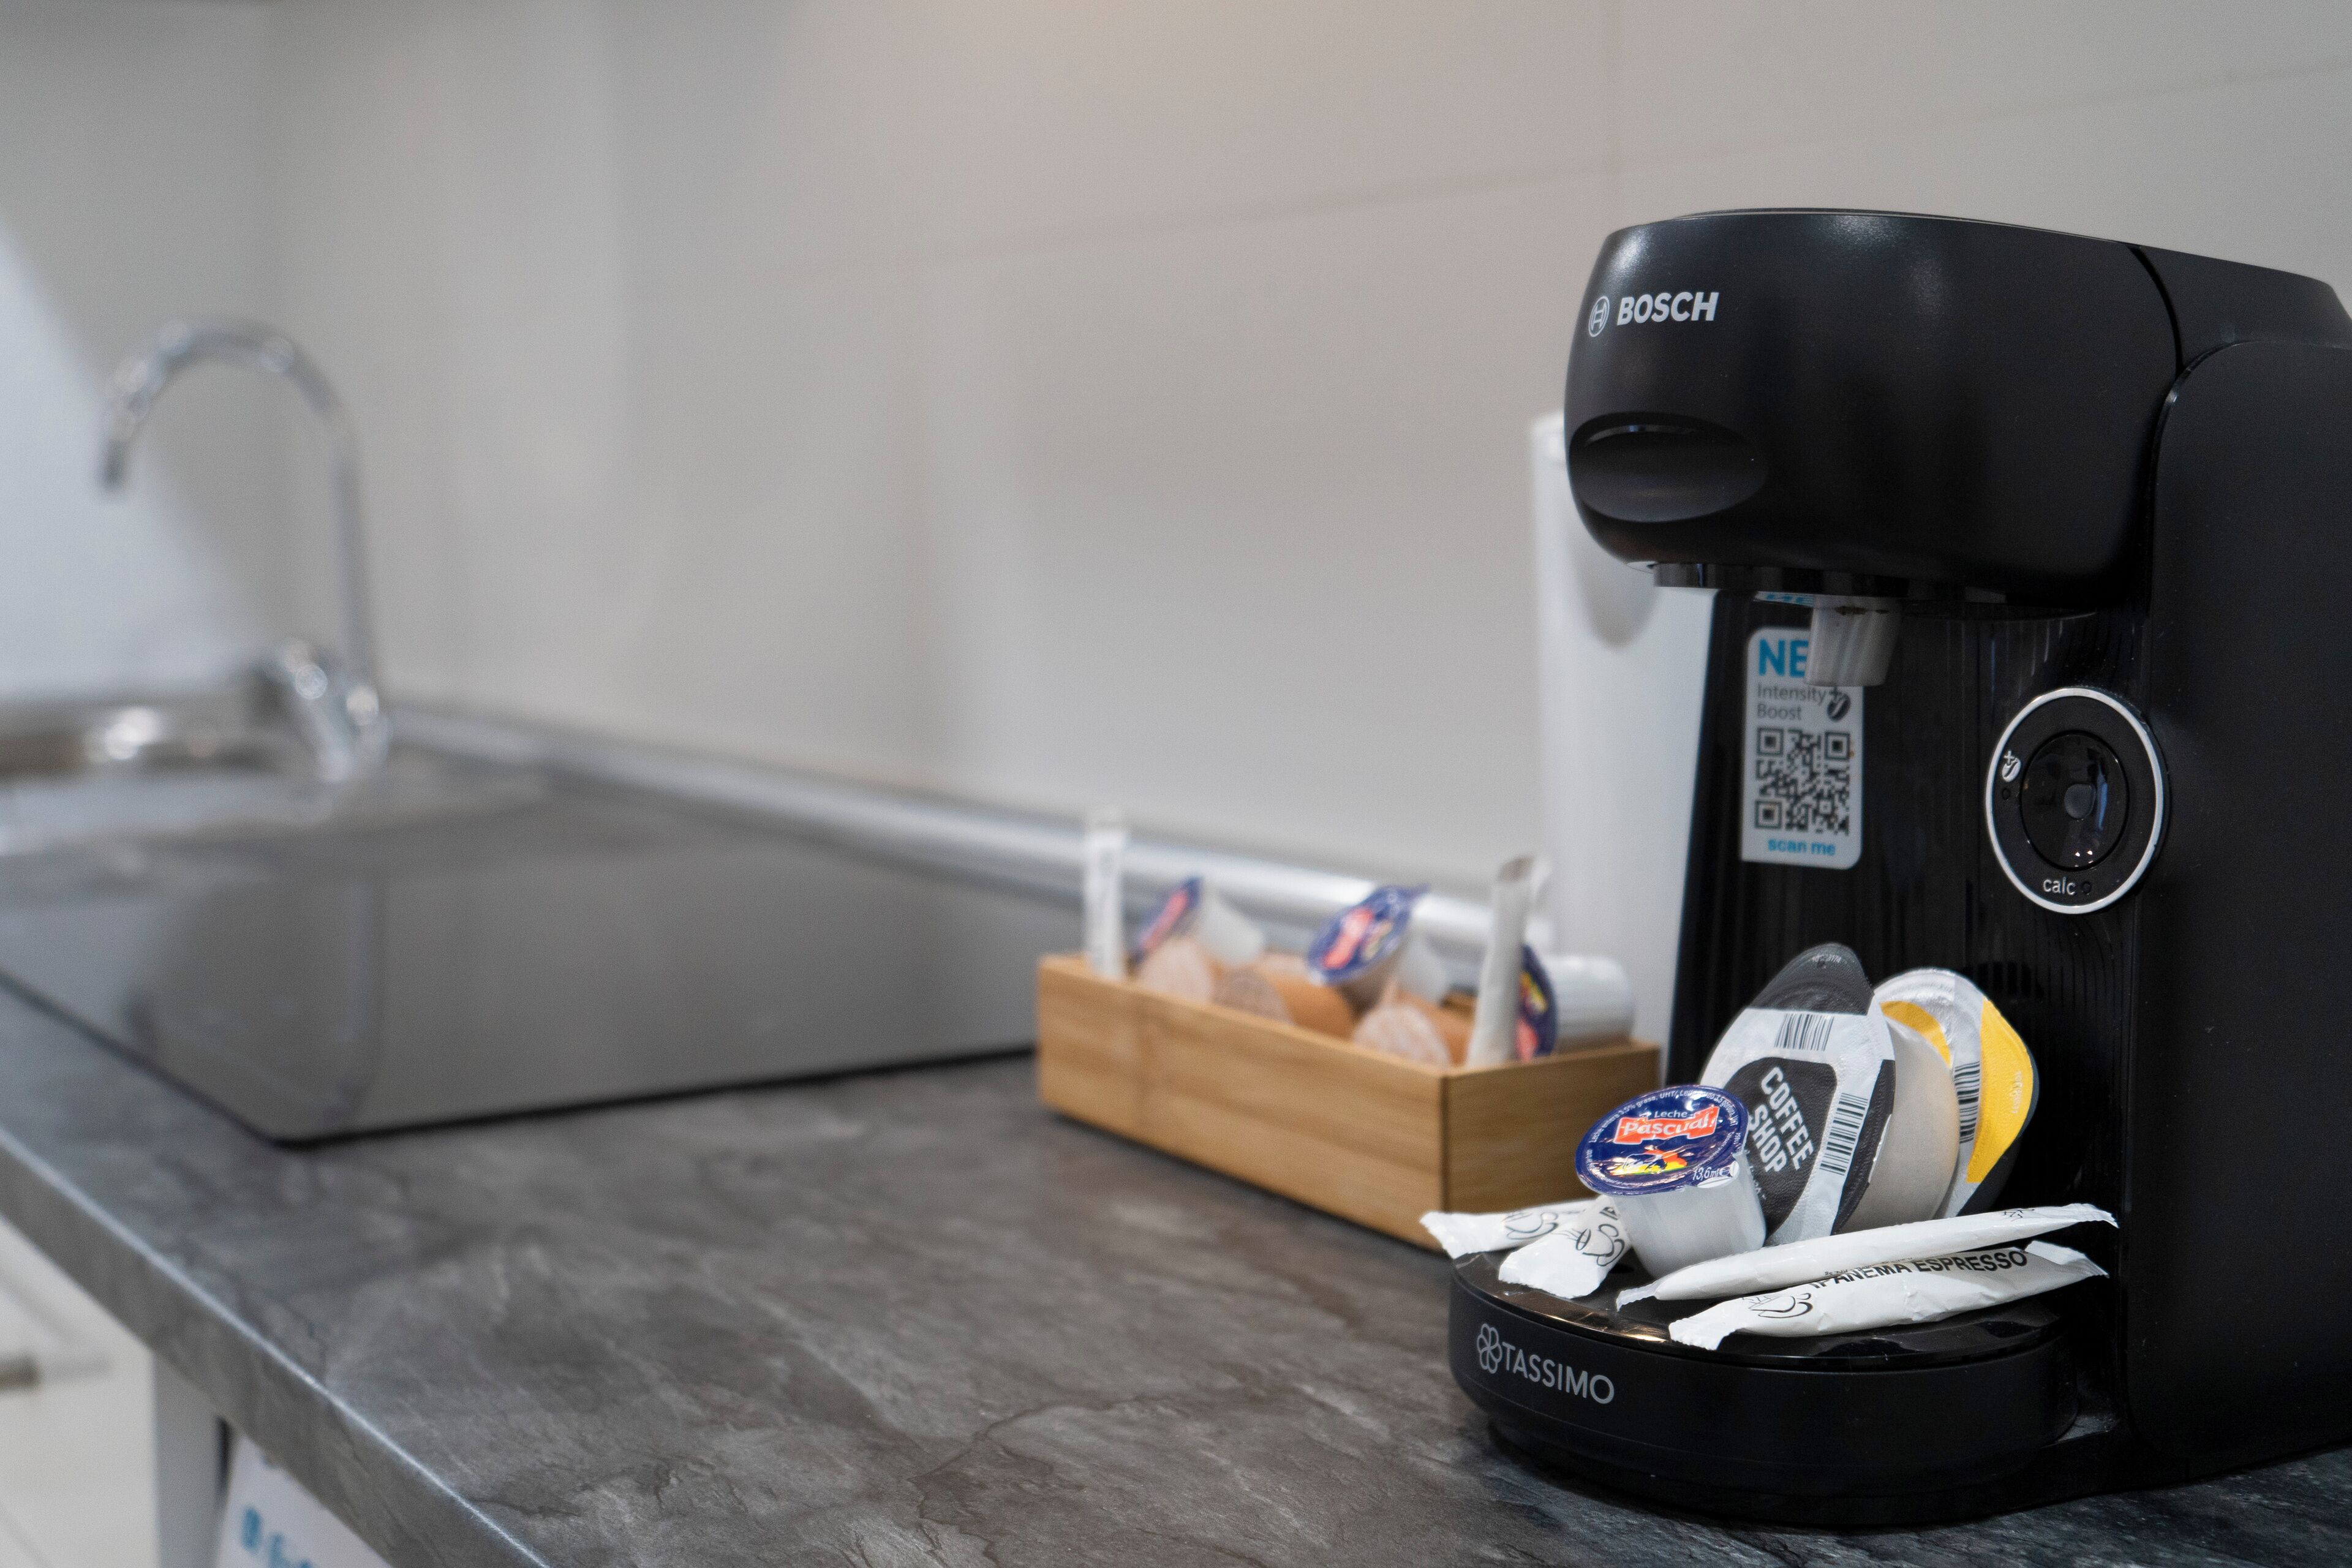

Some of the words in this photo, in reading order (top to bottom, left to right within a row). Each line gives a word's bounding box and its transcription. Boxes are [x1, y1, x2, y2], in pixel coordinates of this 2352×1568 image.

[1616, 291, 1719, 326] BOSCH
[1758, 638, 1809, 678] NE
[1757, 684, 1827, 707] Intensity
[1757, 703, 1802, 721] Boost
[1768, 839, 1807, 853] scan
[1811, 842, 1836, 856] me
[2042, 877, 2076, 896] calc
[1654, 1110, 1687, 1118] Leche
[1761, 1066, 1814, 1171] COFFEE
[1748, 1104, 1787, 1172] SHOP
[1911, 1250, 2028, 1273] ESPRESSO
[1502, 1341, 1615, 1404] TASSIMO
